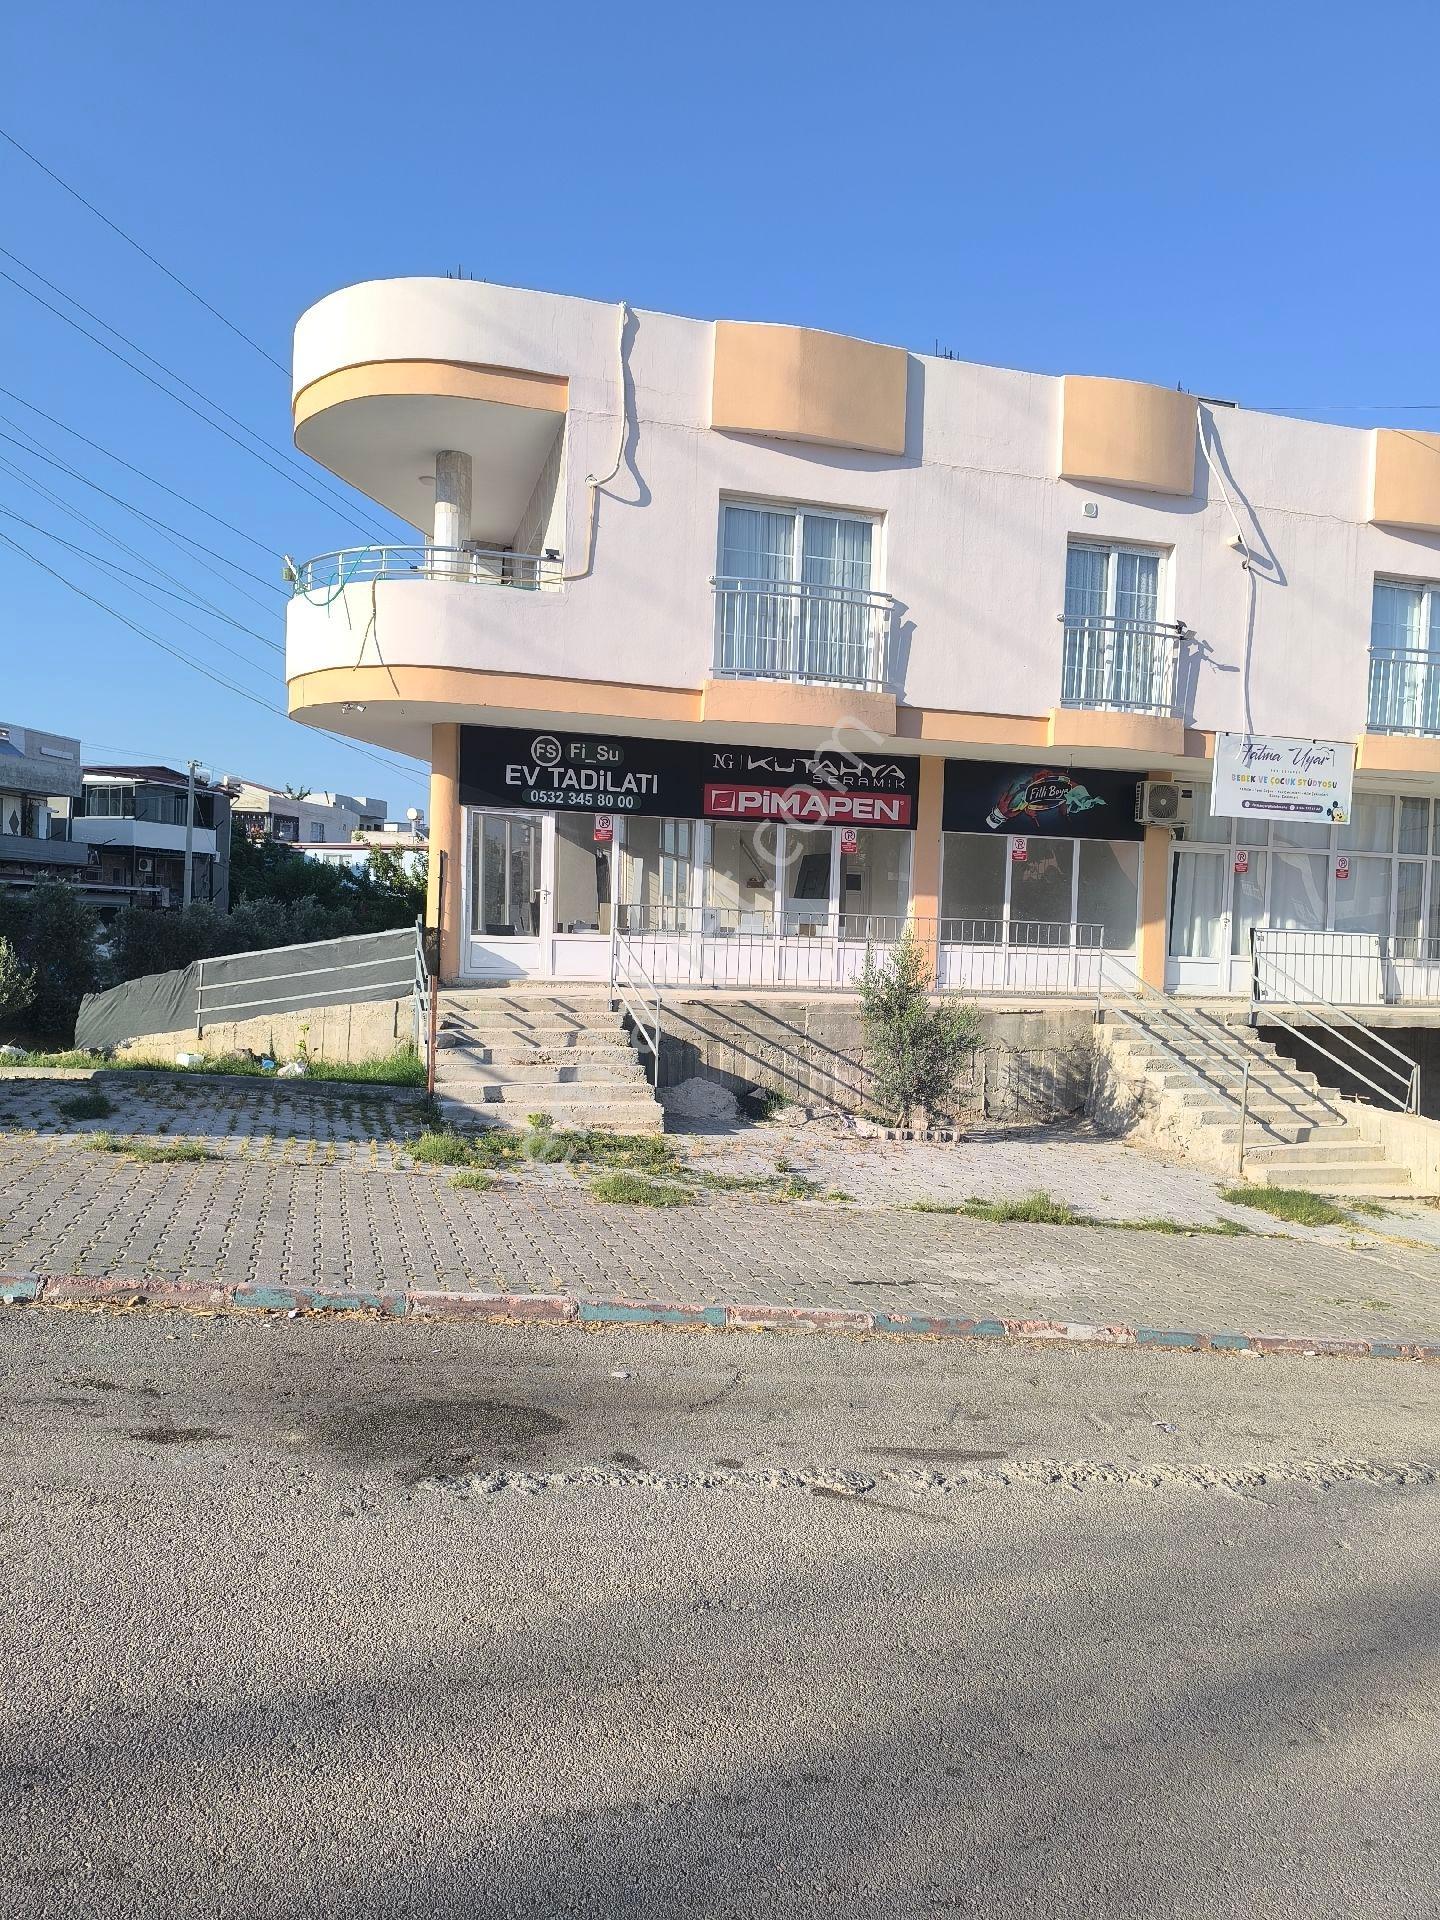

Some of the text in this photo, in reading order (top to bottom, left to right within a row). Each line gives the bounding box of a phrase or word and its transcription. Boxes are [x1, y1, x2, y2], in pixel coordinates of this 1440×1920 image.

[536, 743, 557, 758] FS
[1240, 743, 1282, 764] Fatma
[712, 753, 734, 769] NG
[505, 764, 541, 786] EV
[1231, 773, 1256, 783] BEBEK
[1258, 775, 1268, 784] VE
[530, 789, 634, 809] 0532 345 80 00
[1030, 786, 1048, 800] Filli
